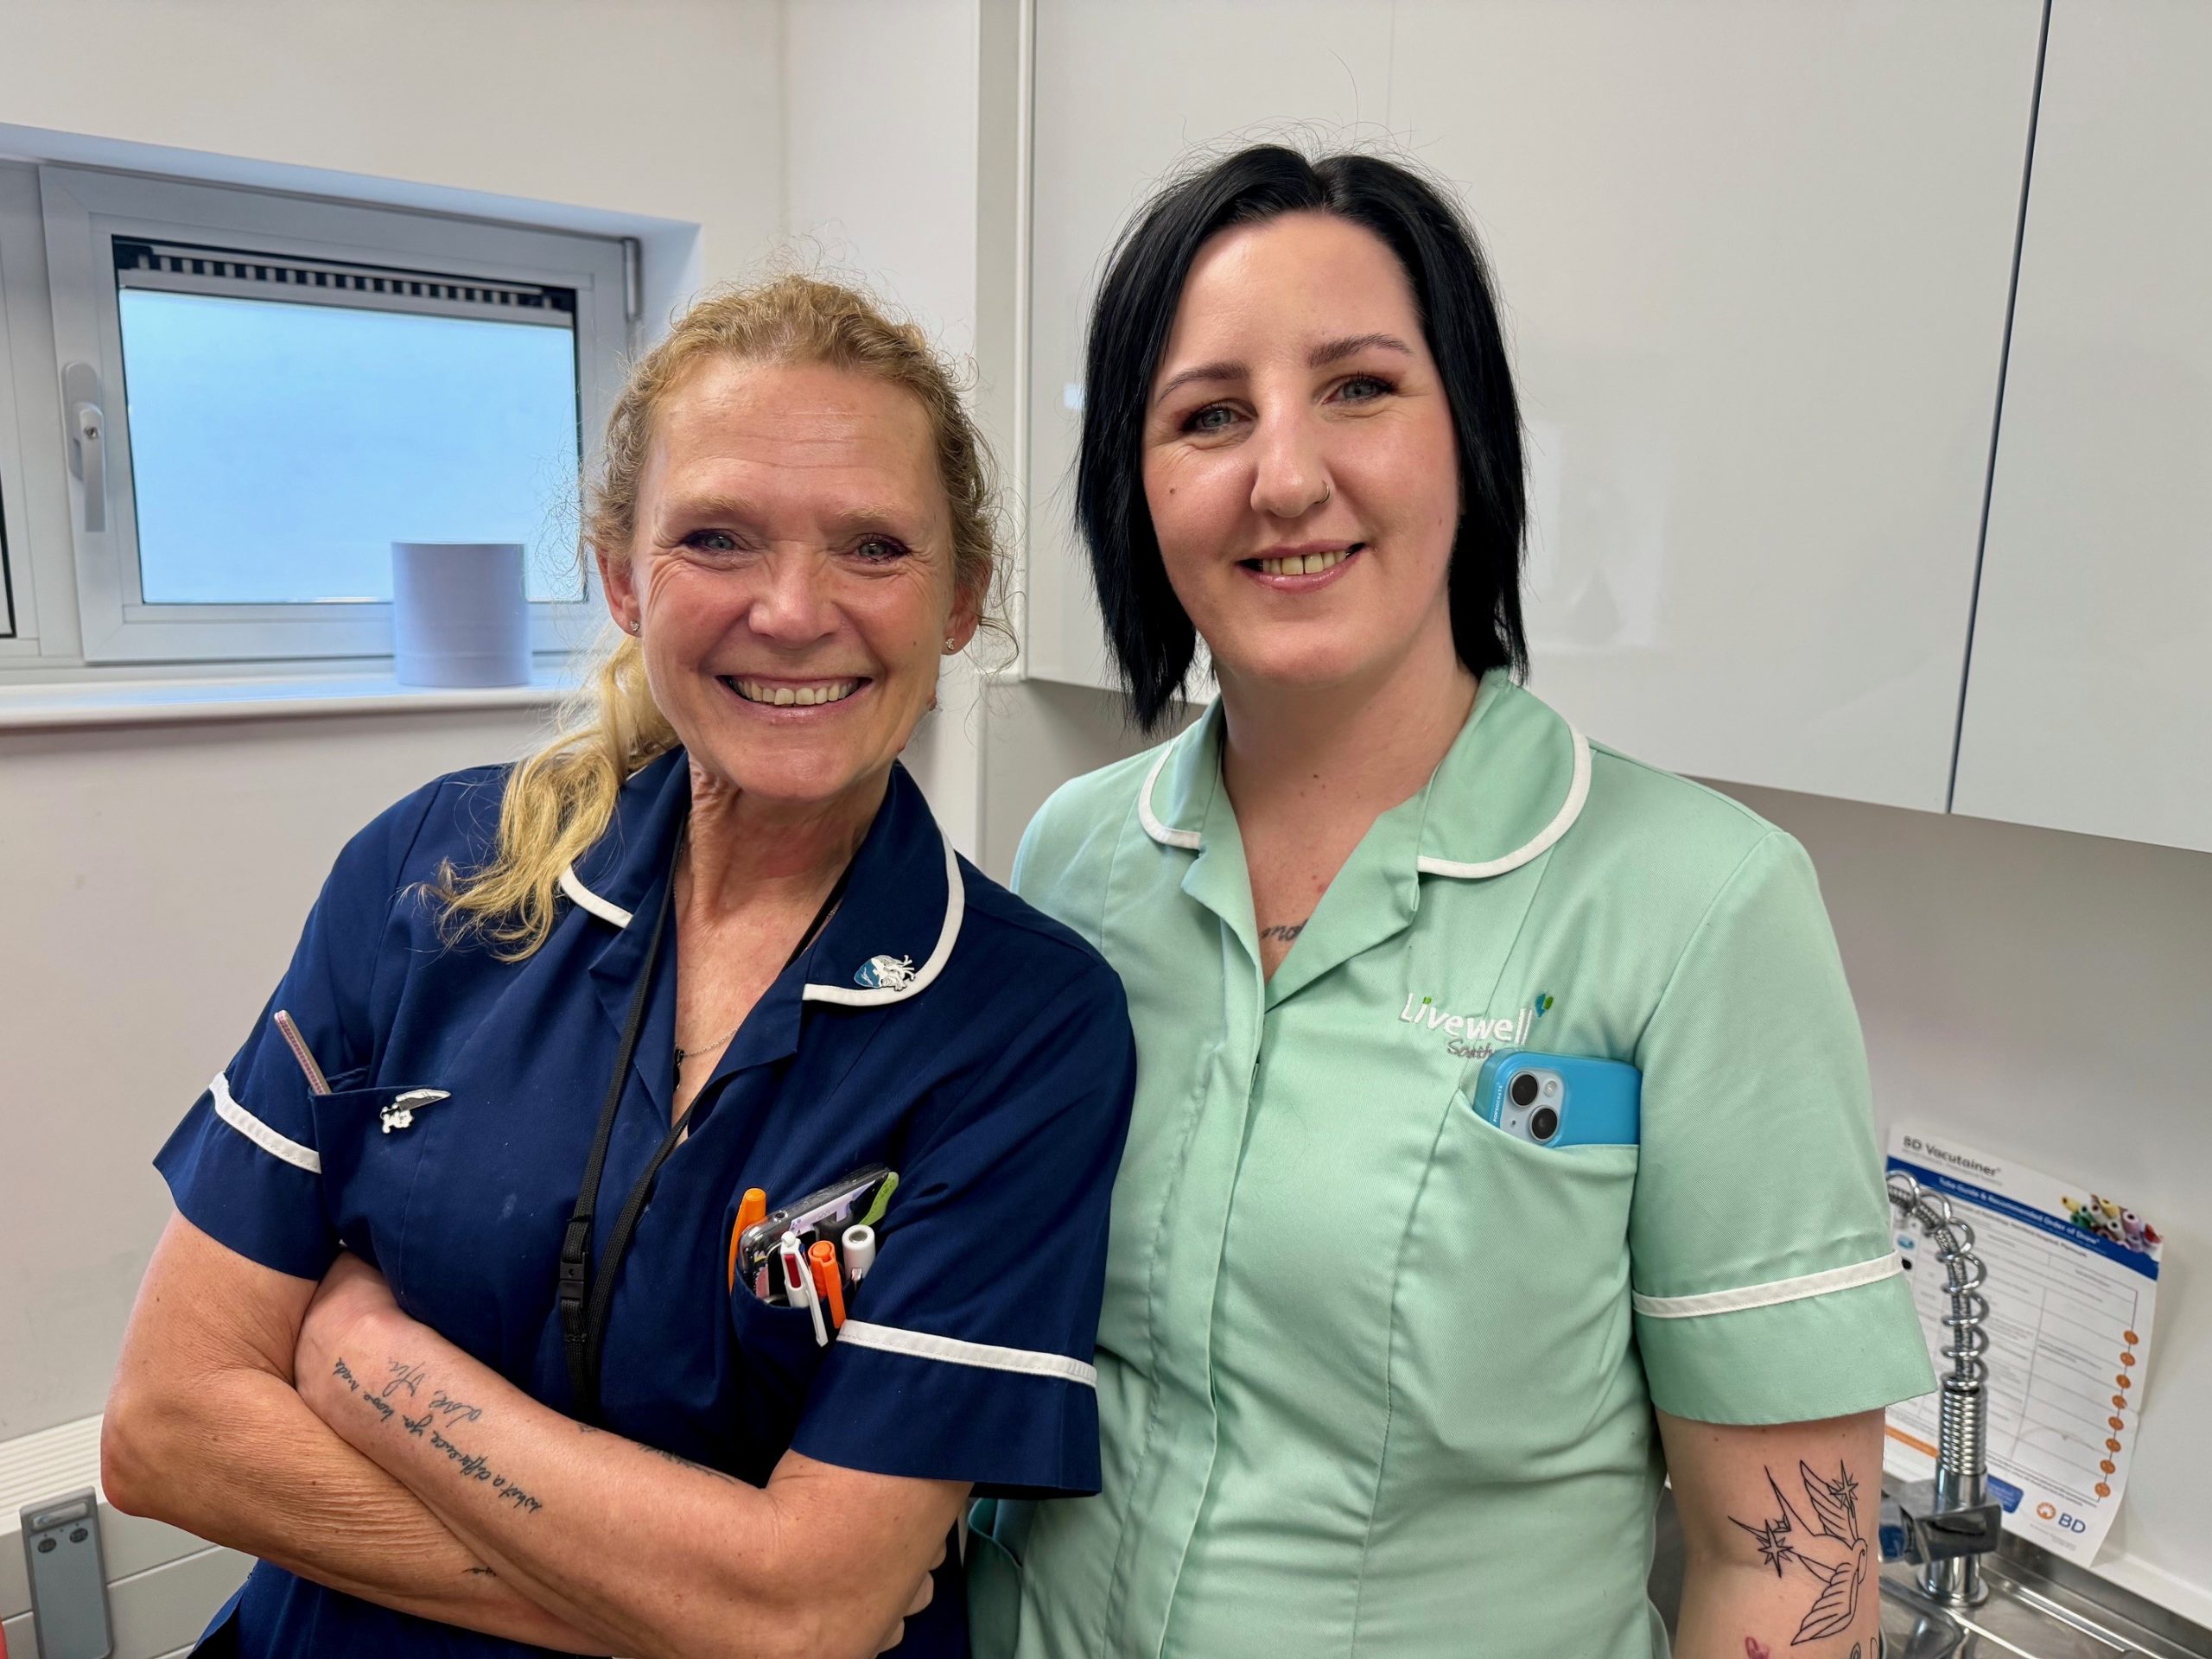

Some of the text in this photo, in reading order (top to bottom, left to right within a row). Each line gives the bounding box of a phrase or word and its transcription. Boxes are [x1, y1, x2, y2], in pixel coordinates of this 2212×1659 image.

[1399, 992, 1534, 1046] Livewell
[1904, 1135, 1923, 1152] BD
[332, 1356, 360, 1392] made
[363, 1389, 395, 1423] have
[403, 1414, 433, 1437] you
[493, 1474, 505, 1487] a
[2057, 1511, 2087, 1534] BD
